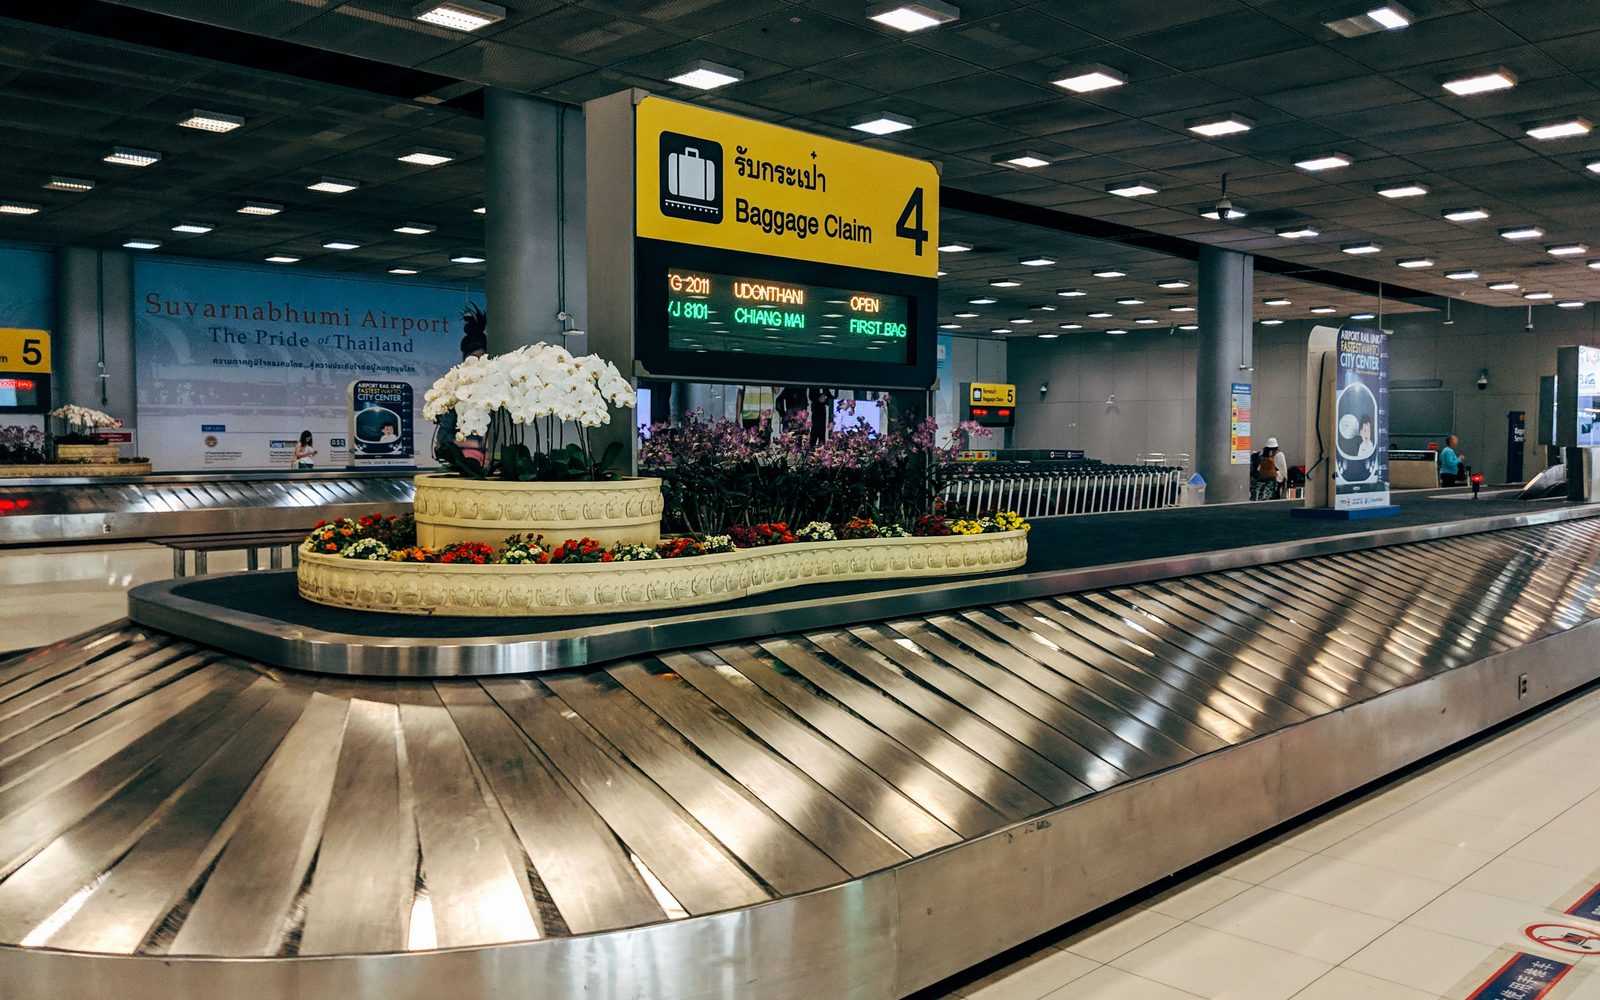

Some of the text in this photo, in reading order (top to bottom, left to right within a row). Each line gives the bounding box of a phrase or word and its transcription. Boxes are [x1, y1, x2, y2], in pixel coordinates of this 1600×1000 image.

[735, 145, 826, 192] รับกระเป๋า
[736, 197, 872, 244] Baggage Claim
[896, 187, 928, 256] 4
[668, 274, 879, 313] G 2011 UDONTHANI OPEN
[145, 292, 449, 337] Suvarnabhumi Airport
[684, 302, 708, 319] 8101
[735, 307, 781, 326] CHIANG
[784, 312, 805, 328] MAI
[850, 318, 882, 335] FIRST
[884, 322, 907, 338] BAG
[22, 339, 42, 365] 5
[208, 326, 414, 353] The Pride of Thailand
[1341, 330, 1360, 340] AIRPORT
[1360, 332, 1370, 343] RAIL
[1341, 341, 1361, 353] FASTEST
[1341, 352, 1379, 370] CITY CENTER
[1007, 389, 1013, 402] 5
[1494, 960, 1554, 1000] 使用手推车
